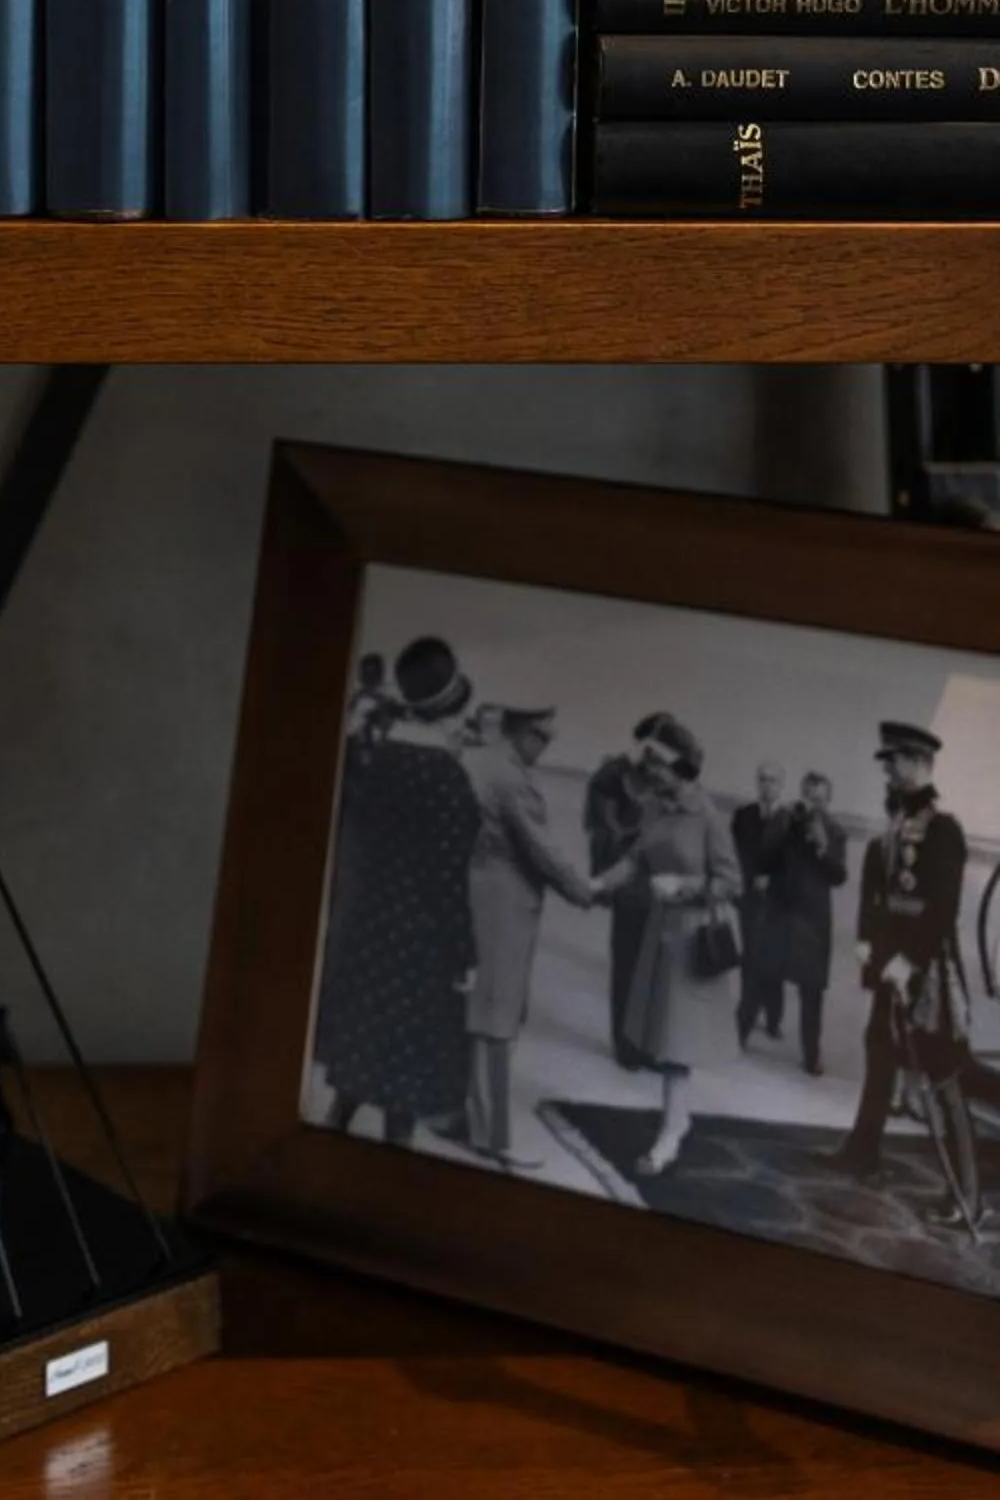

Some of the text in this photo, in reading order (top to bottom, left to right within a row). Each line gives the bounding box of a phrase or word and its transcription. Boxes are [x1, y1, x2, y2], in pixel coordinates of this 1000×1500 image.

[671, 69, 692, 88] A.
[701, 69, 790, 89] DAUDET
[852, 69, 945, 90] CONTES
[734, 121, 765, 209] THAÏS
